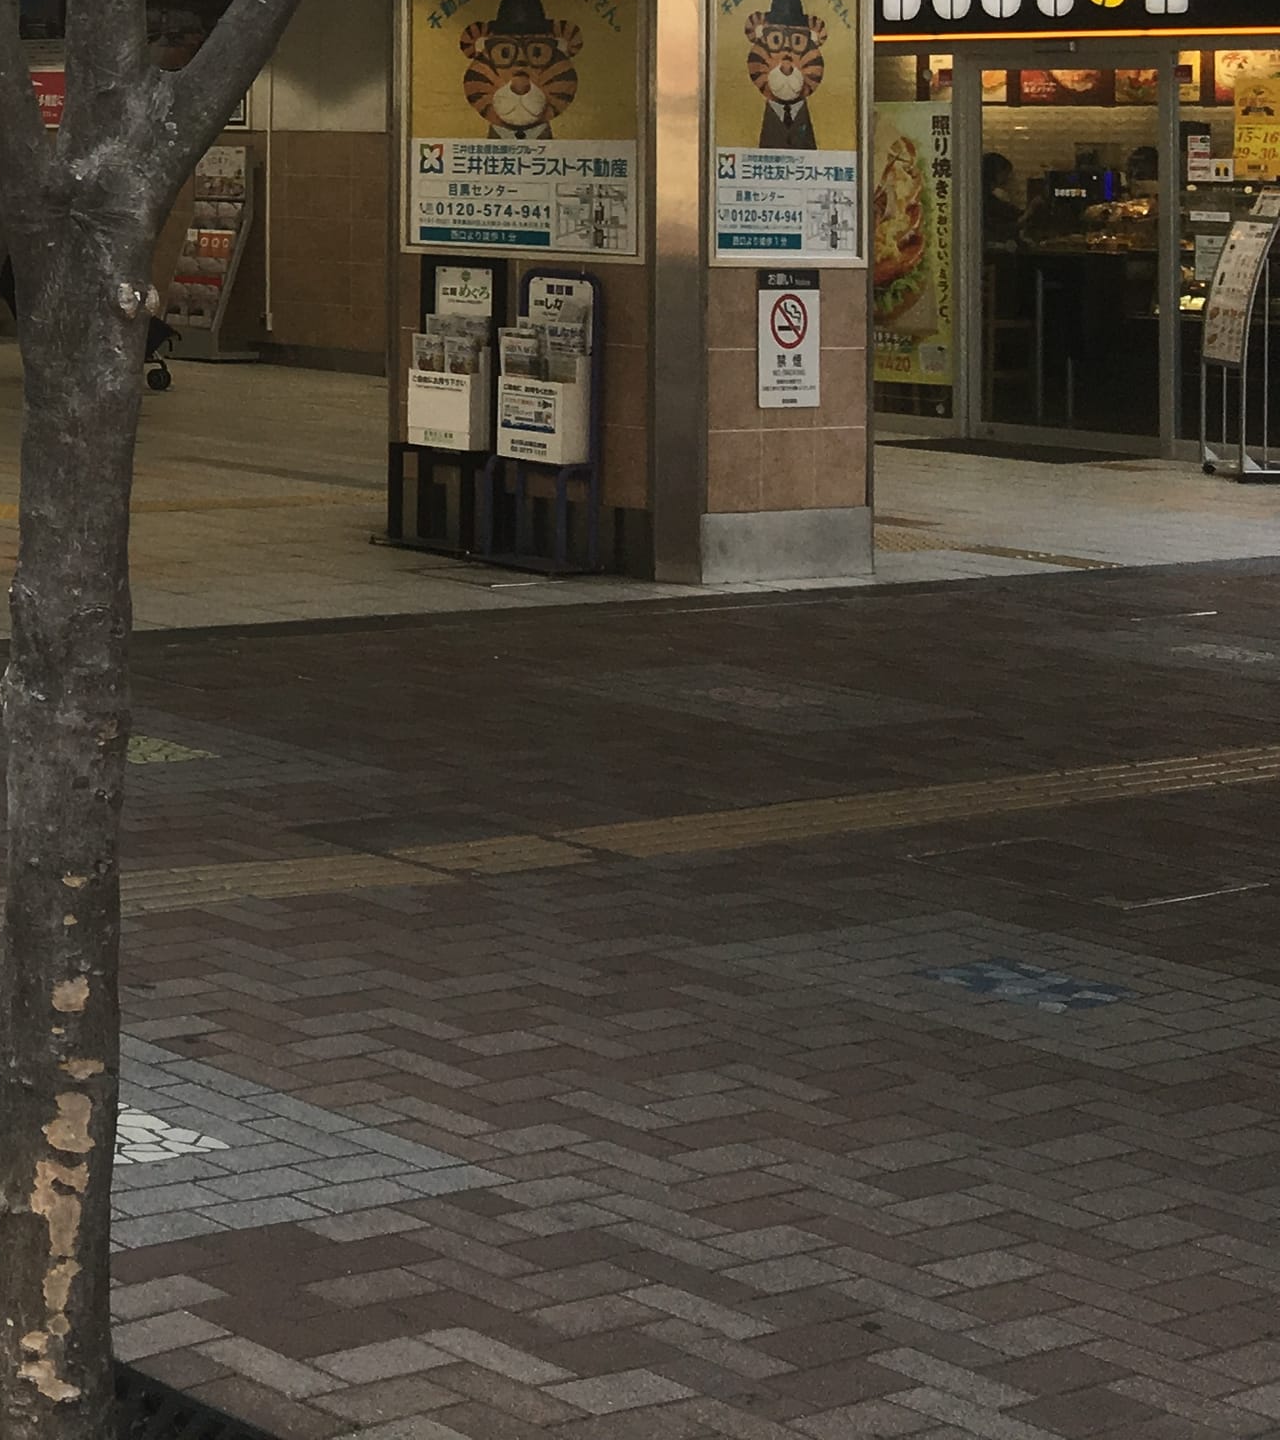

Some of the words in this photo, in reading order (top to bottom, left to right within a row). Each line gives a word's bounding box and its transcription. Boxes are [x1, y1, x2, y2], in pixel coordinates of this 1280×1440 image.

[451, 156, 628, 178] 三井住友トラスト不動産
[741, 163, 856, 182] 三井住友トラスト不動産
[448, 182, 518, 197] 目黒センター
[735, 189, 785, 202] 目黒センター
[435, 201, 551, 219] 0120-574-941
[731, 208, 803, 223] 0120-574-941
